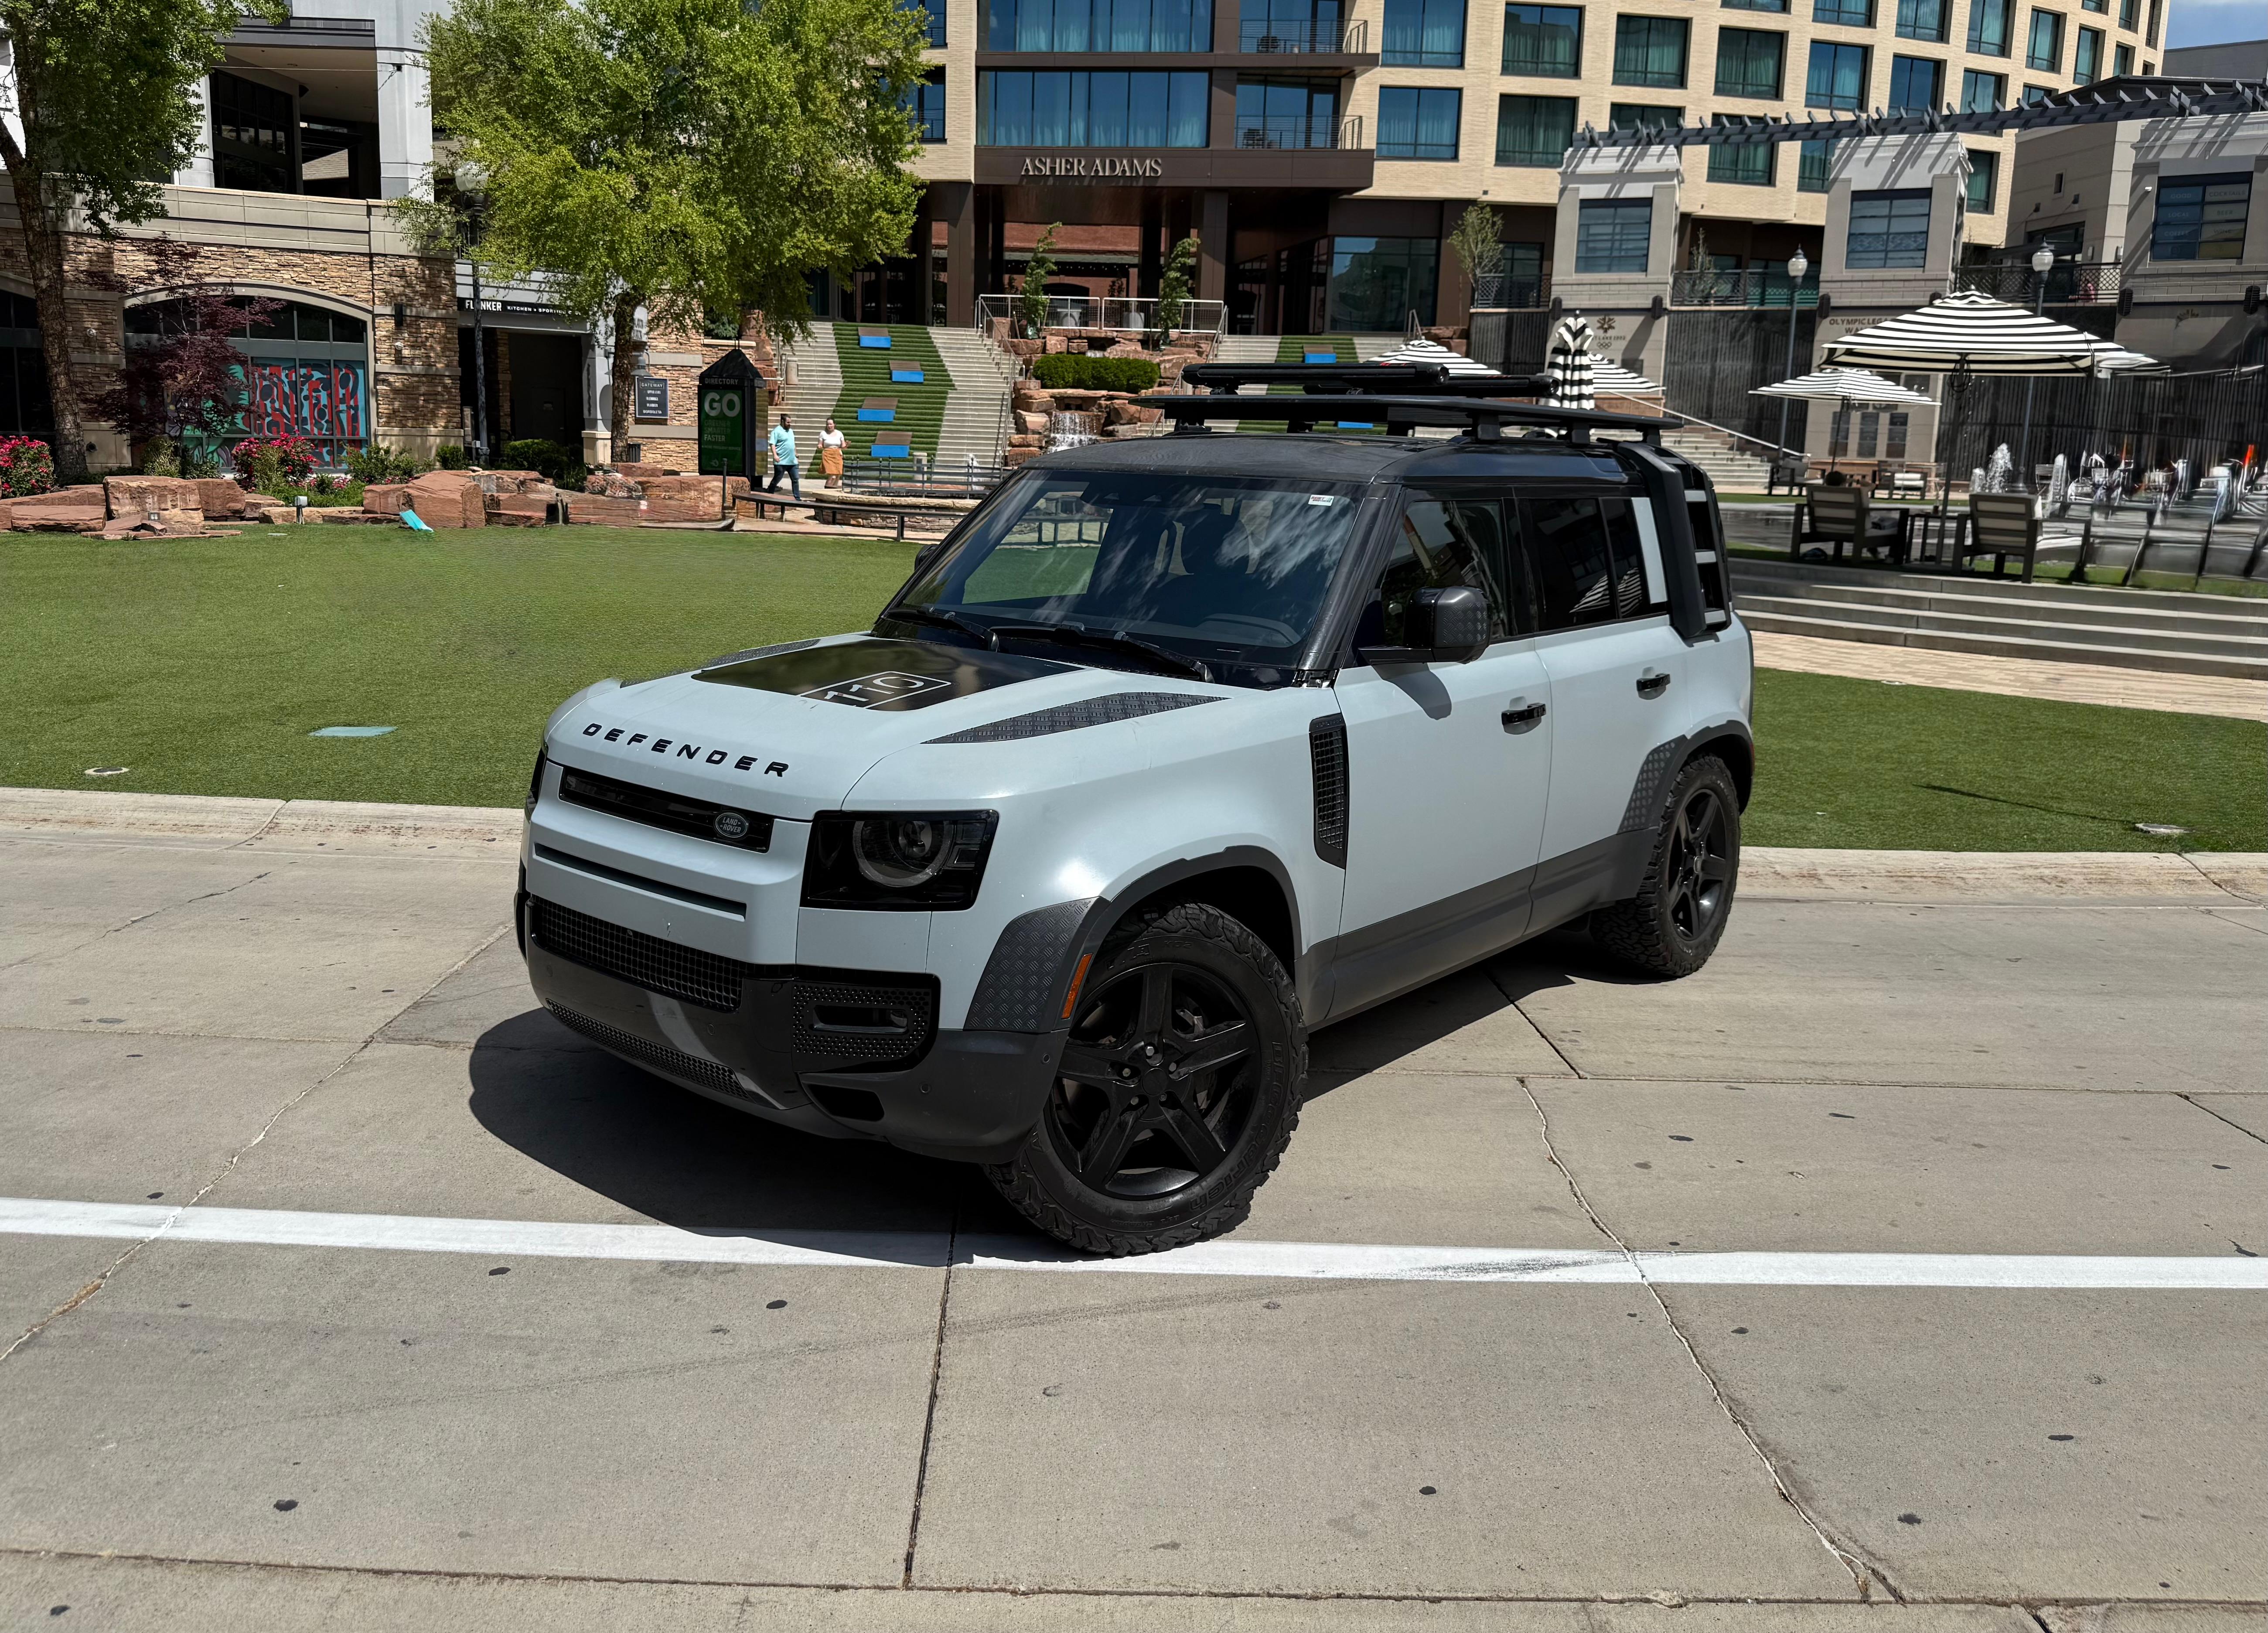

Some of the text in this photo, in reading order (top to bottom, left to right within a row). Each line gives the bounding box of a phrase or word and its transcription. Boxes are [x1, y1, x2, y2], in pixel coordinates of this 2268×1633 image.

[1021, 157, 1162, 177] ASHER ADAMS
[465, 300, 501, 311] FLNKER
[704, 392, 740, 417] GO
[824, 676, 924, 702] 110
[582, 723, 789, 777] DEFENDER
[723, 816, 738, 825] LAND
[723, 824, 741, 833] ROVER
